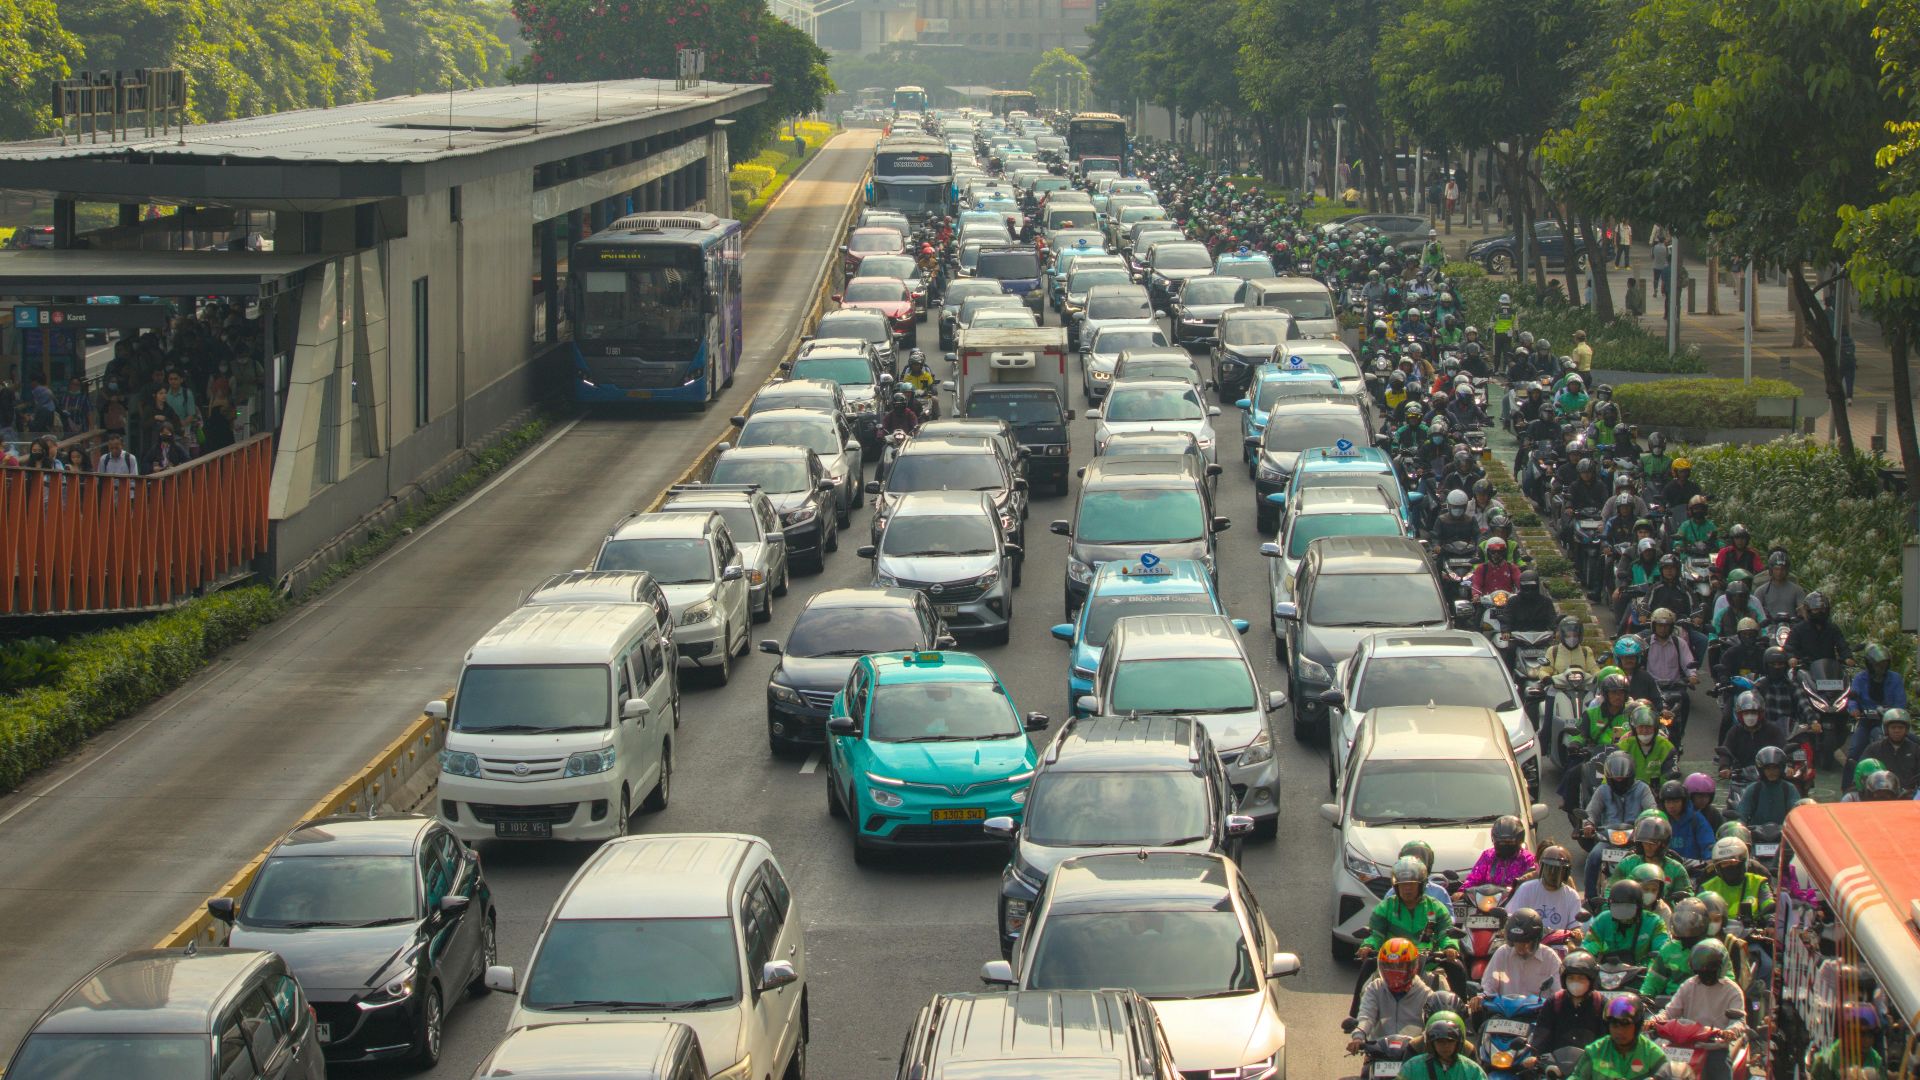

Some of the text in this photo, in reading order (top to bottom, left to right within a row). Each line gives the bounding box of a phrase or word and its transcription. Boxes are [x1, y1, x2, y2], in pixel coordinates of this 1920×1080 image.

[66, 313, 87, 321] Karet
[934, 811, 940, 820] B
[943, 810, 964, 820] 1303
[500, 822, 505, 832] B
[510, 822, 528, 832] 1012
